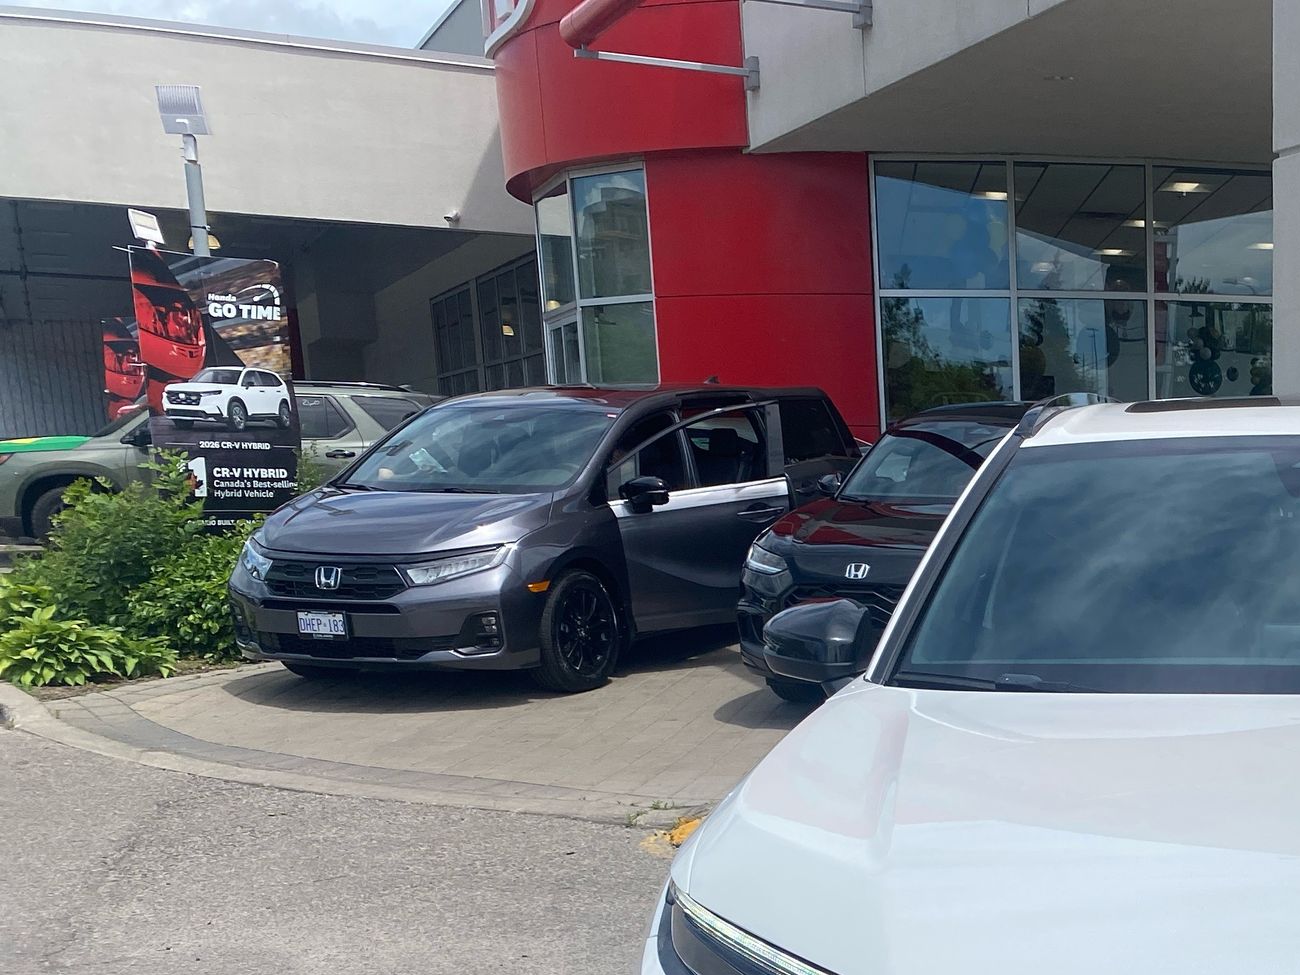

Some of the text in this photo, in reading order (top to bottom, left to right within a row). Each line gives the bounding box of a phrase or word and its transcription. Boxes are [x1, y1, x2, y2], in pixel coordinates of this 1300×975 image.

[208, 293, 237, 302] Honda
[208, 302, 281, 321] GO TIME
[199, 441, 271, 450] 2026 CR-V HYBRID
[212, 467, 288, 478] CR-V HYBRID
[213, 479, 251, 488] Canada's
[214, 489, 243, 499] Hybrid
[299, 617, 322, 632] DHEP
